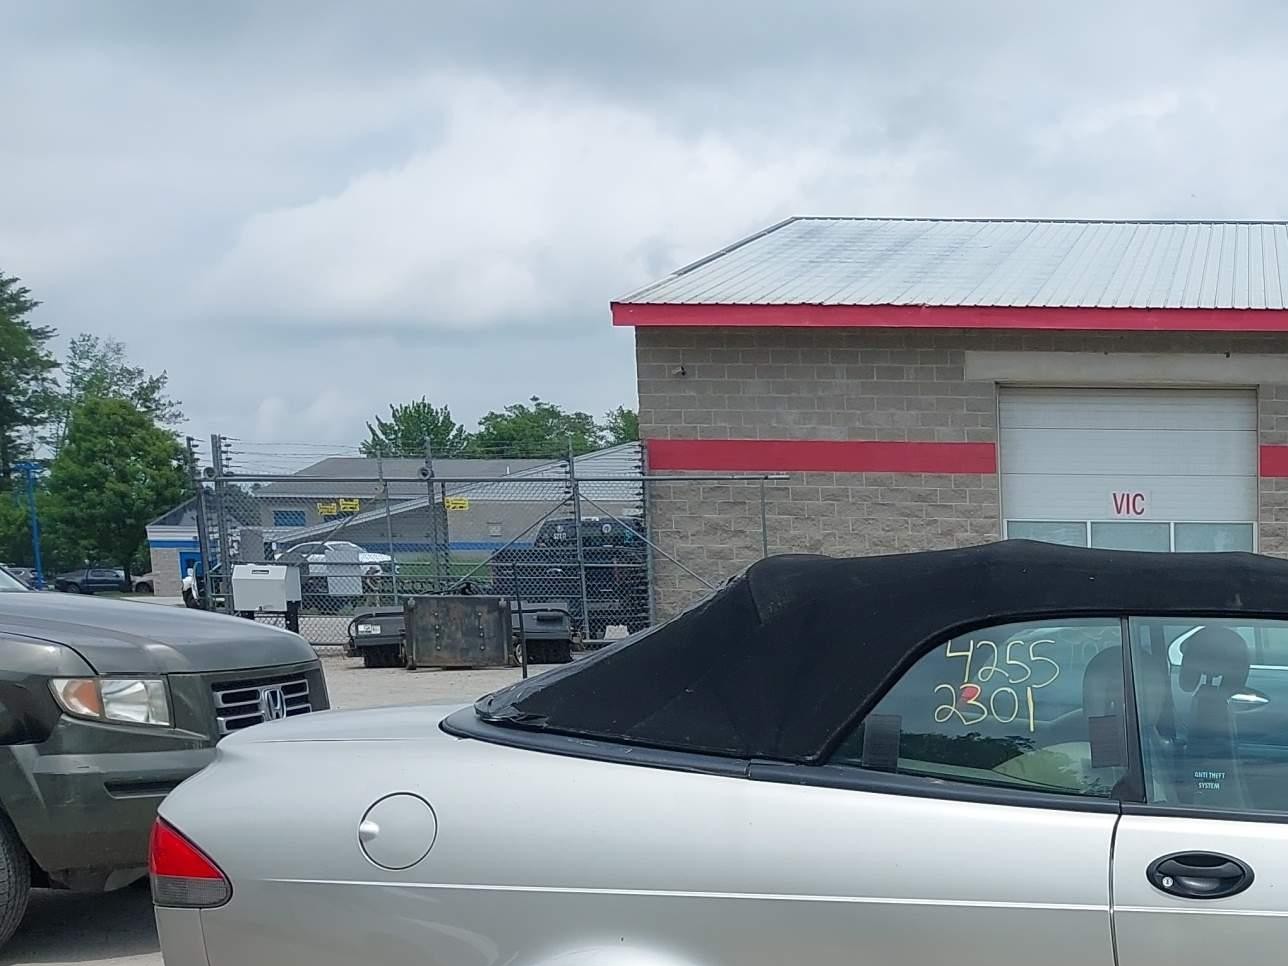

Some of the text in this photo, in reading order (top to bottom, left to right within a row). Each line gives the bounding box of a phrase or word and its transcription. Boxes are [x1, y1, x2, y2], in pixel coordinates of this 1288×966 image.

[1112, 492, 1145, 515] VIC
[945, 639, 1060, 689] 4255
[934, 683, 1035, 732] 2301
